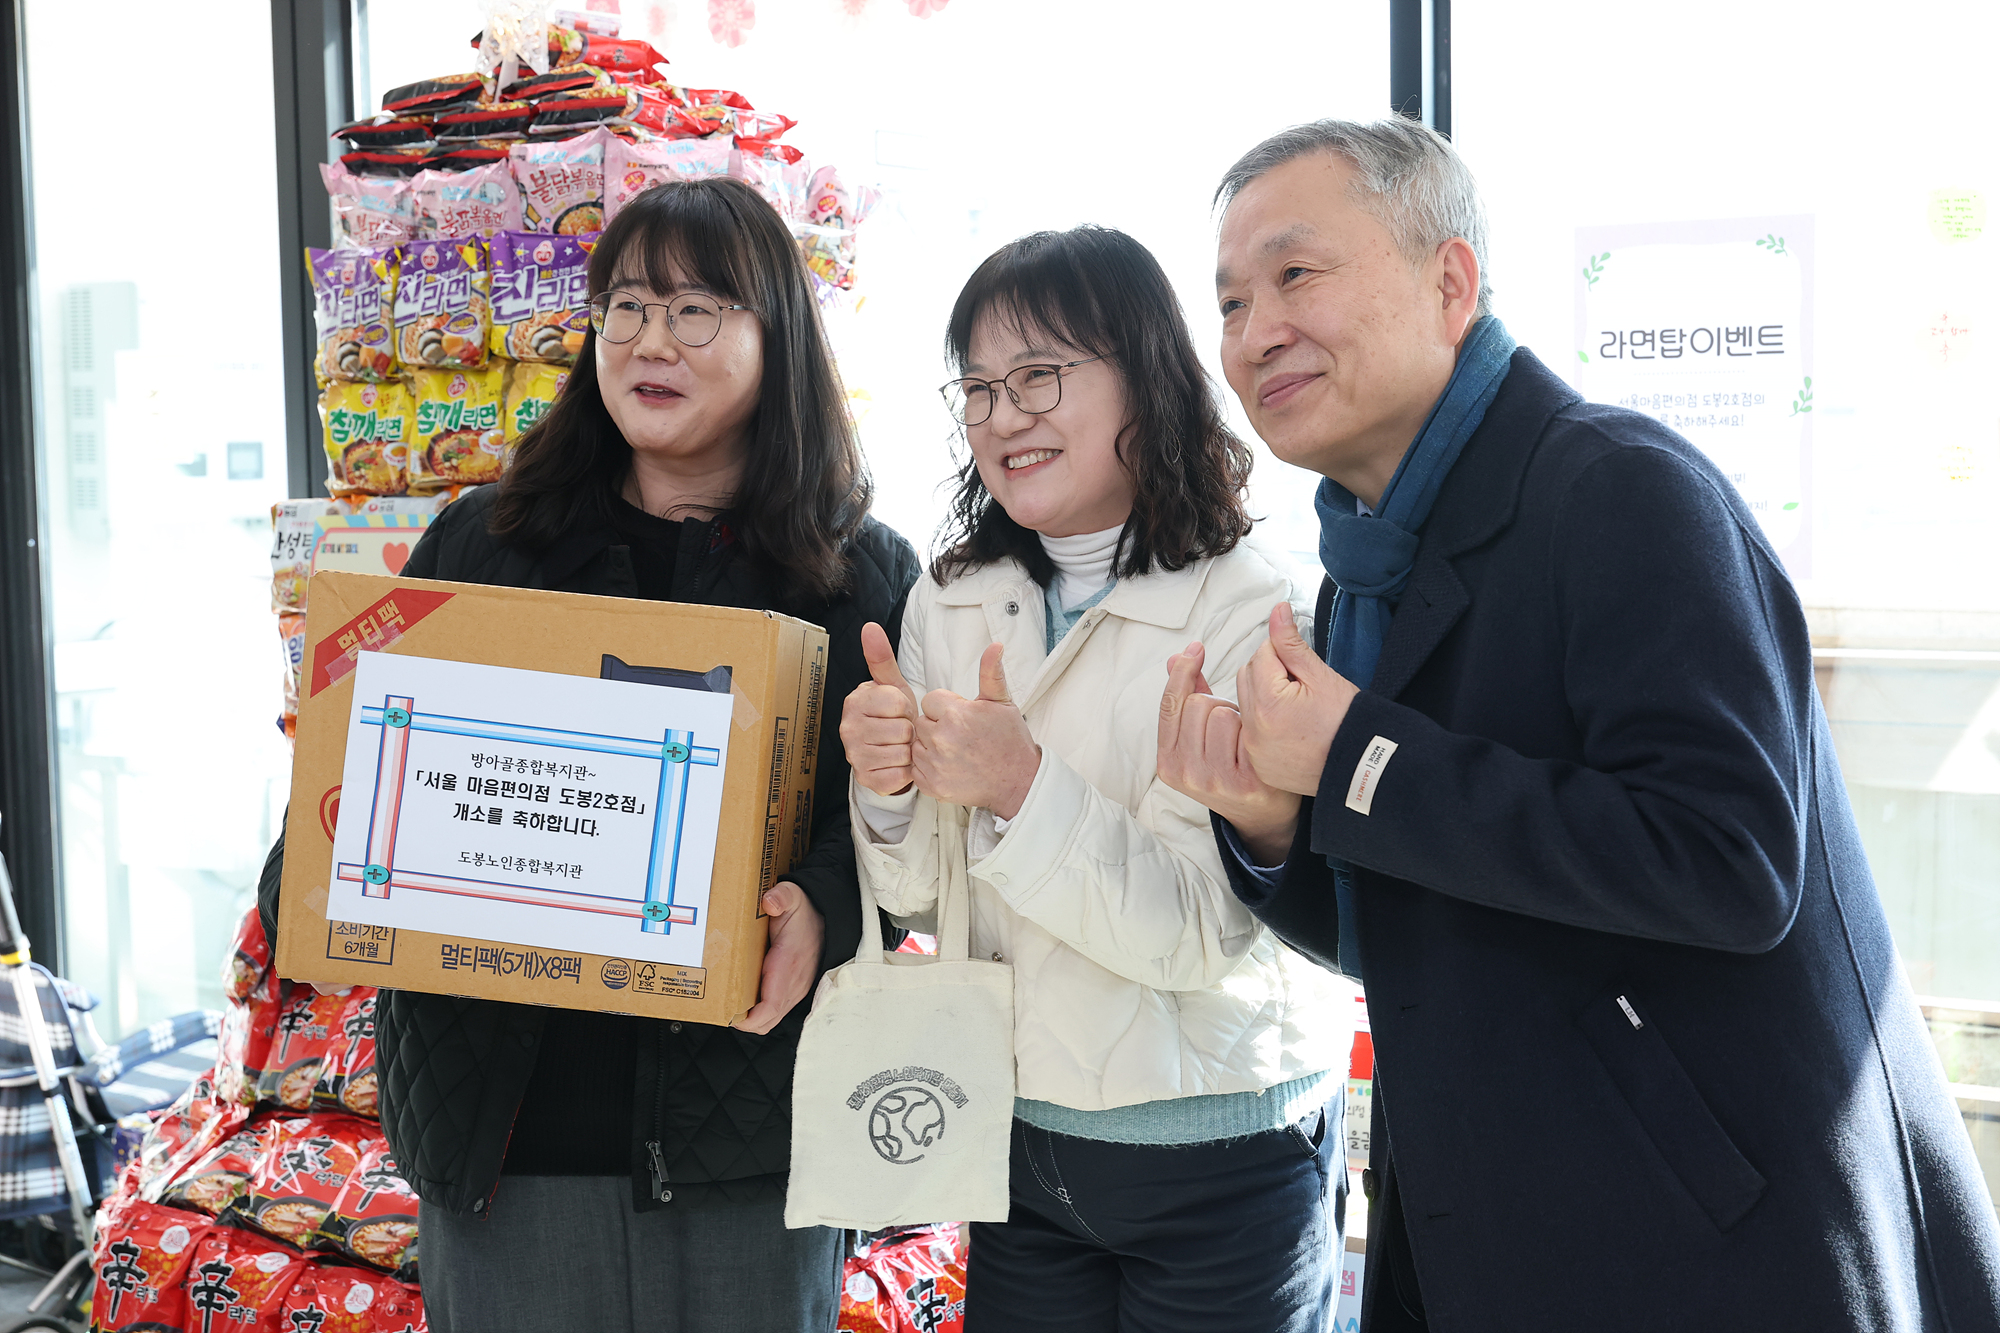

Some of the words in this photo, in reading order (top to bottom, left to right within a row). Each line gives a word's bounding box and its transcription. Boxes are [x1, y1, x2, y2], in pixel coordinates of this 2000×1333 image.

[1600, 325, 1785, 359] 라면탑이벤트
[1702, 392, 1765, 408] 도봉2호점의
[328, 407, 403, 443] 참깨라면
[417, 399, 499, 434] 참깨라면
[1674, 413, 1745, 430] 축하해주세요!
[337, 599, 405, 662] 멀티팩
[471, 752, 597, 782] 방아골종합복지관~
[467, 776, 551, 803] 마음편의점
[453, 802, 503, 826] 개소를
[512, 810, 600, 837] 축하합니다.
[457, 850, 584, 880] 도봉노인종합복지관
[344, 941, 379, 958] 6개월
[441, 943, 582, 984] 멀티팩(5개)X8팩
[605, 968, 627, 976] HACCP
